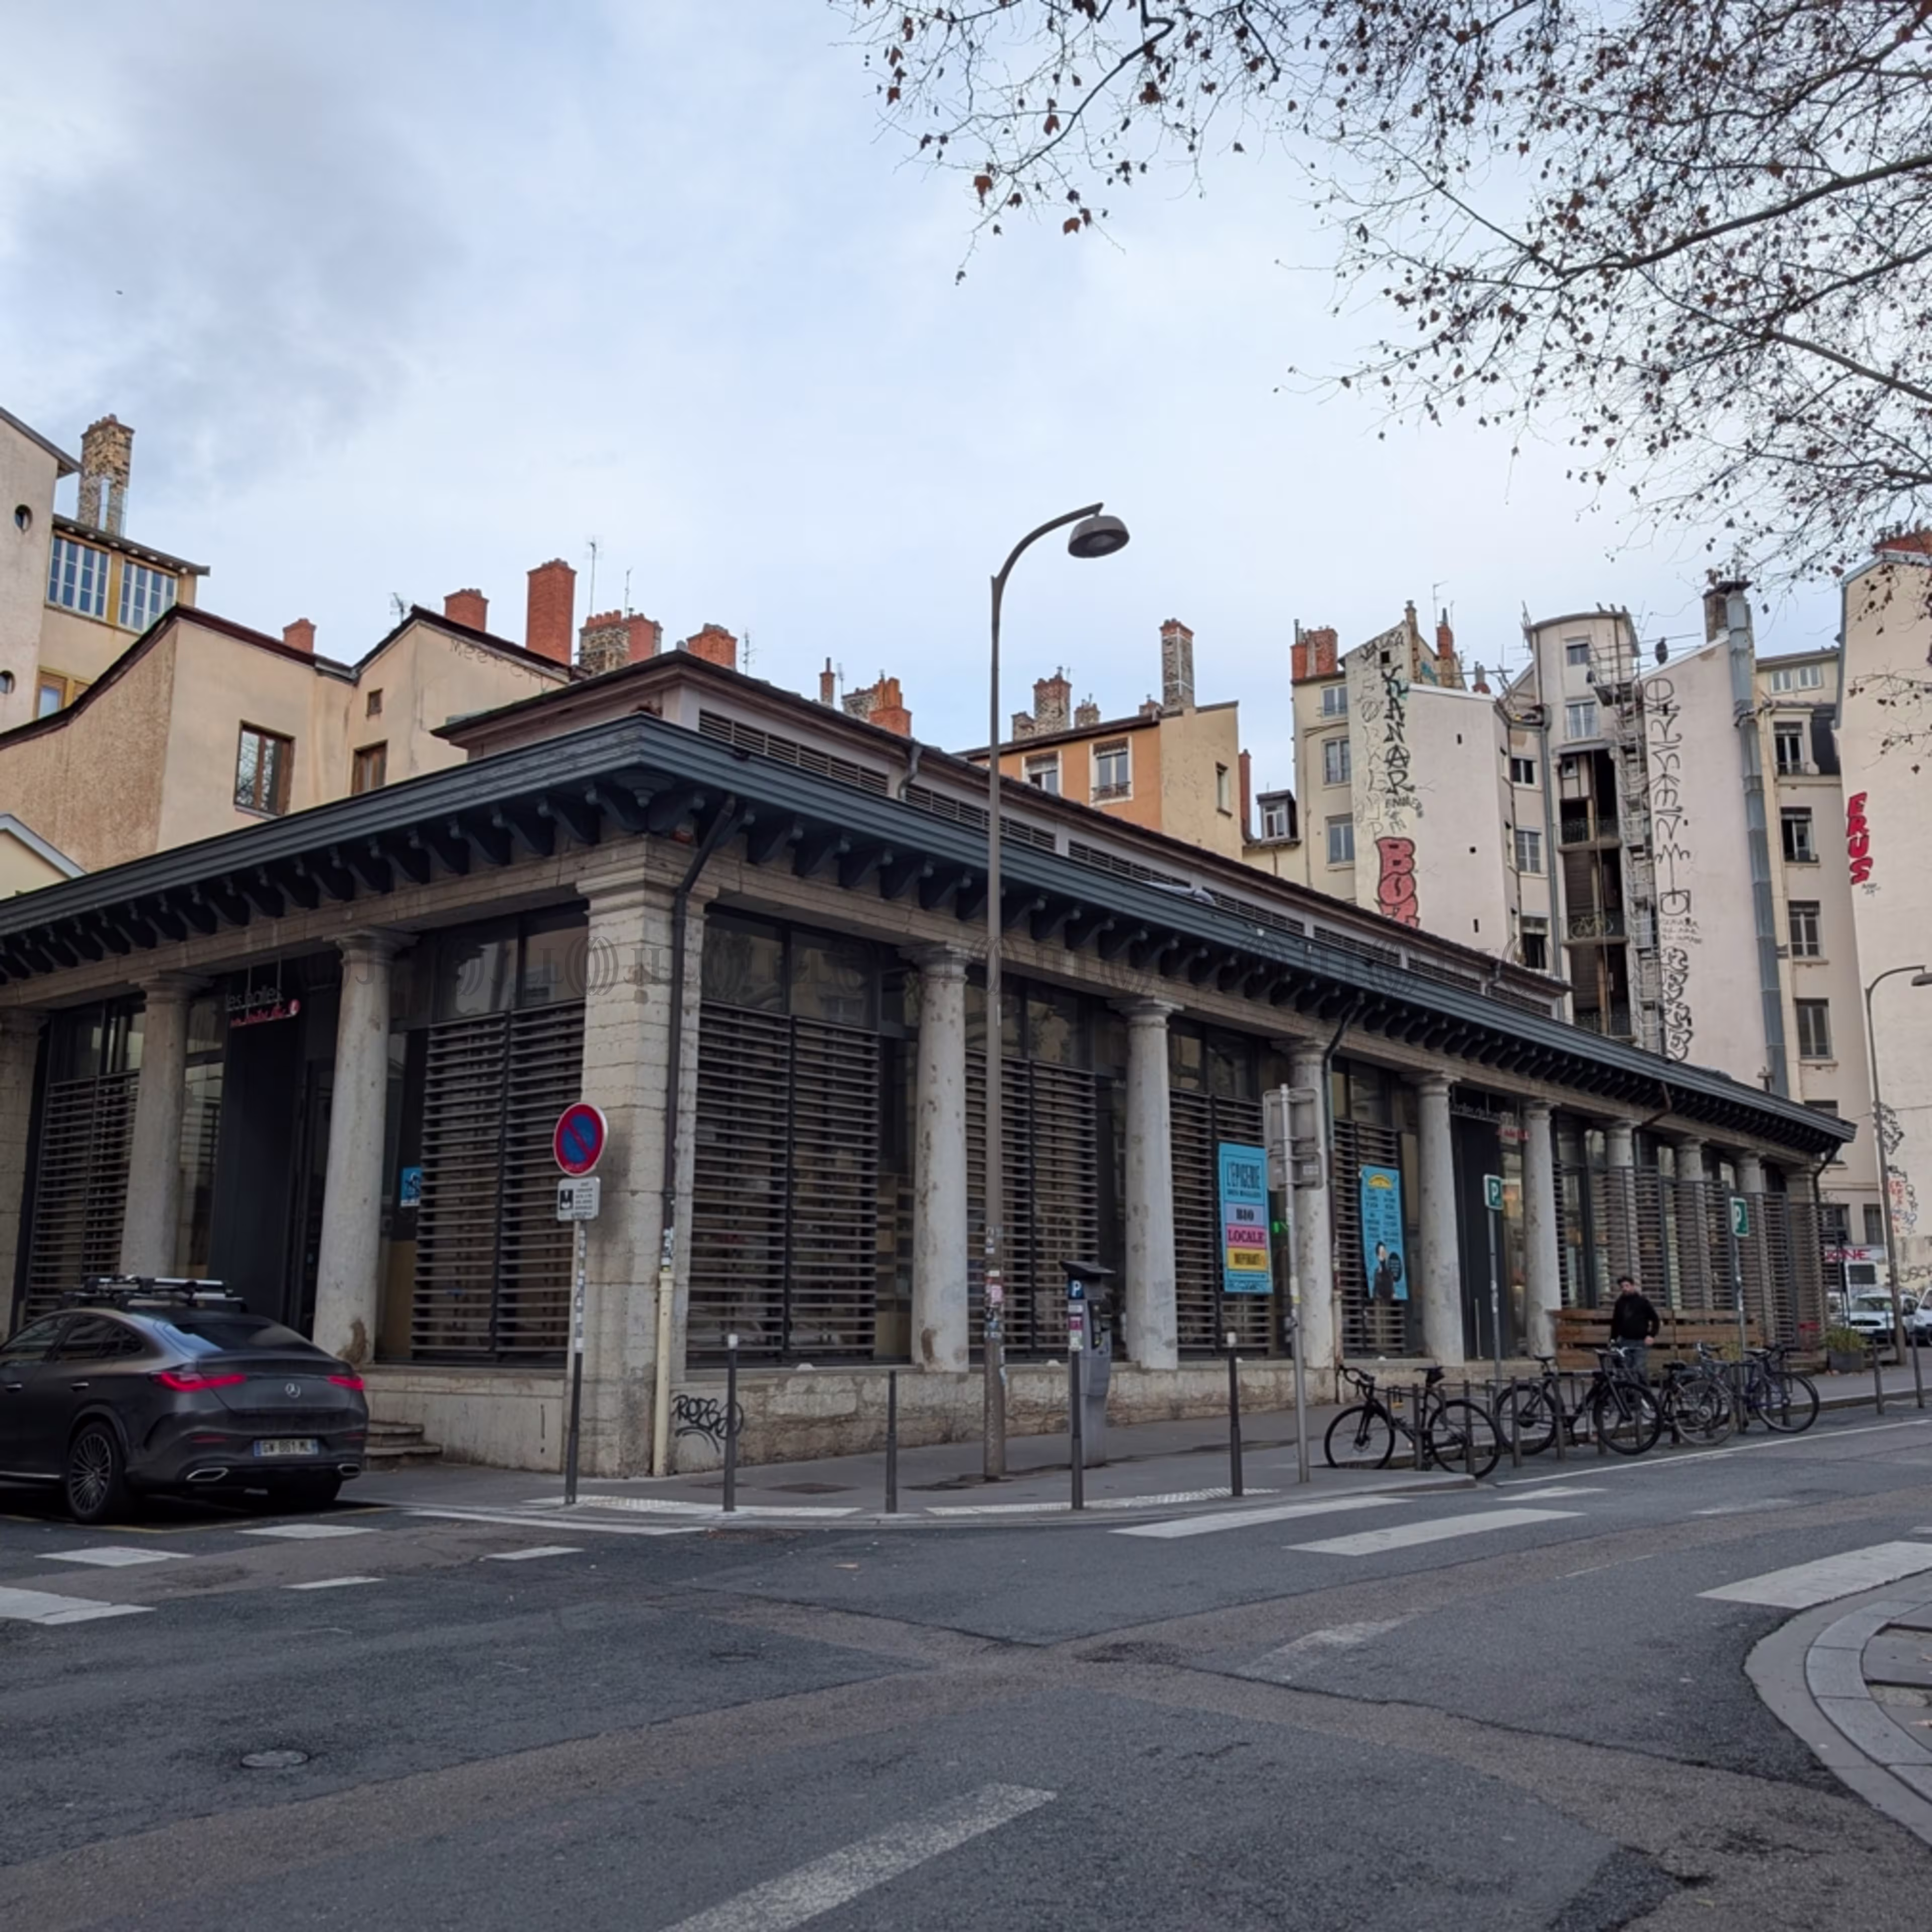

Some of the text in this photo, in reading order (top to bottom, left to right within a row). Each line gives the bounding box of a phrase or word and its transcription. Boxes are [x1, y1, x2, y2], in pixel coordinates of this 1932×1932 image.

[1490, 1181, 1498, 1201] P
[1236, 1208, 1254, 1222] BIO
[1734, 1205, 1742, 1230] P
[1228, 1229, 1265, 1244] LOCALE
[1071, 1280, 1082, 1298] P
